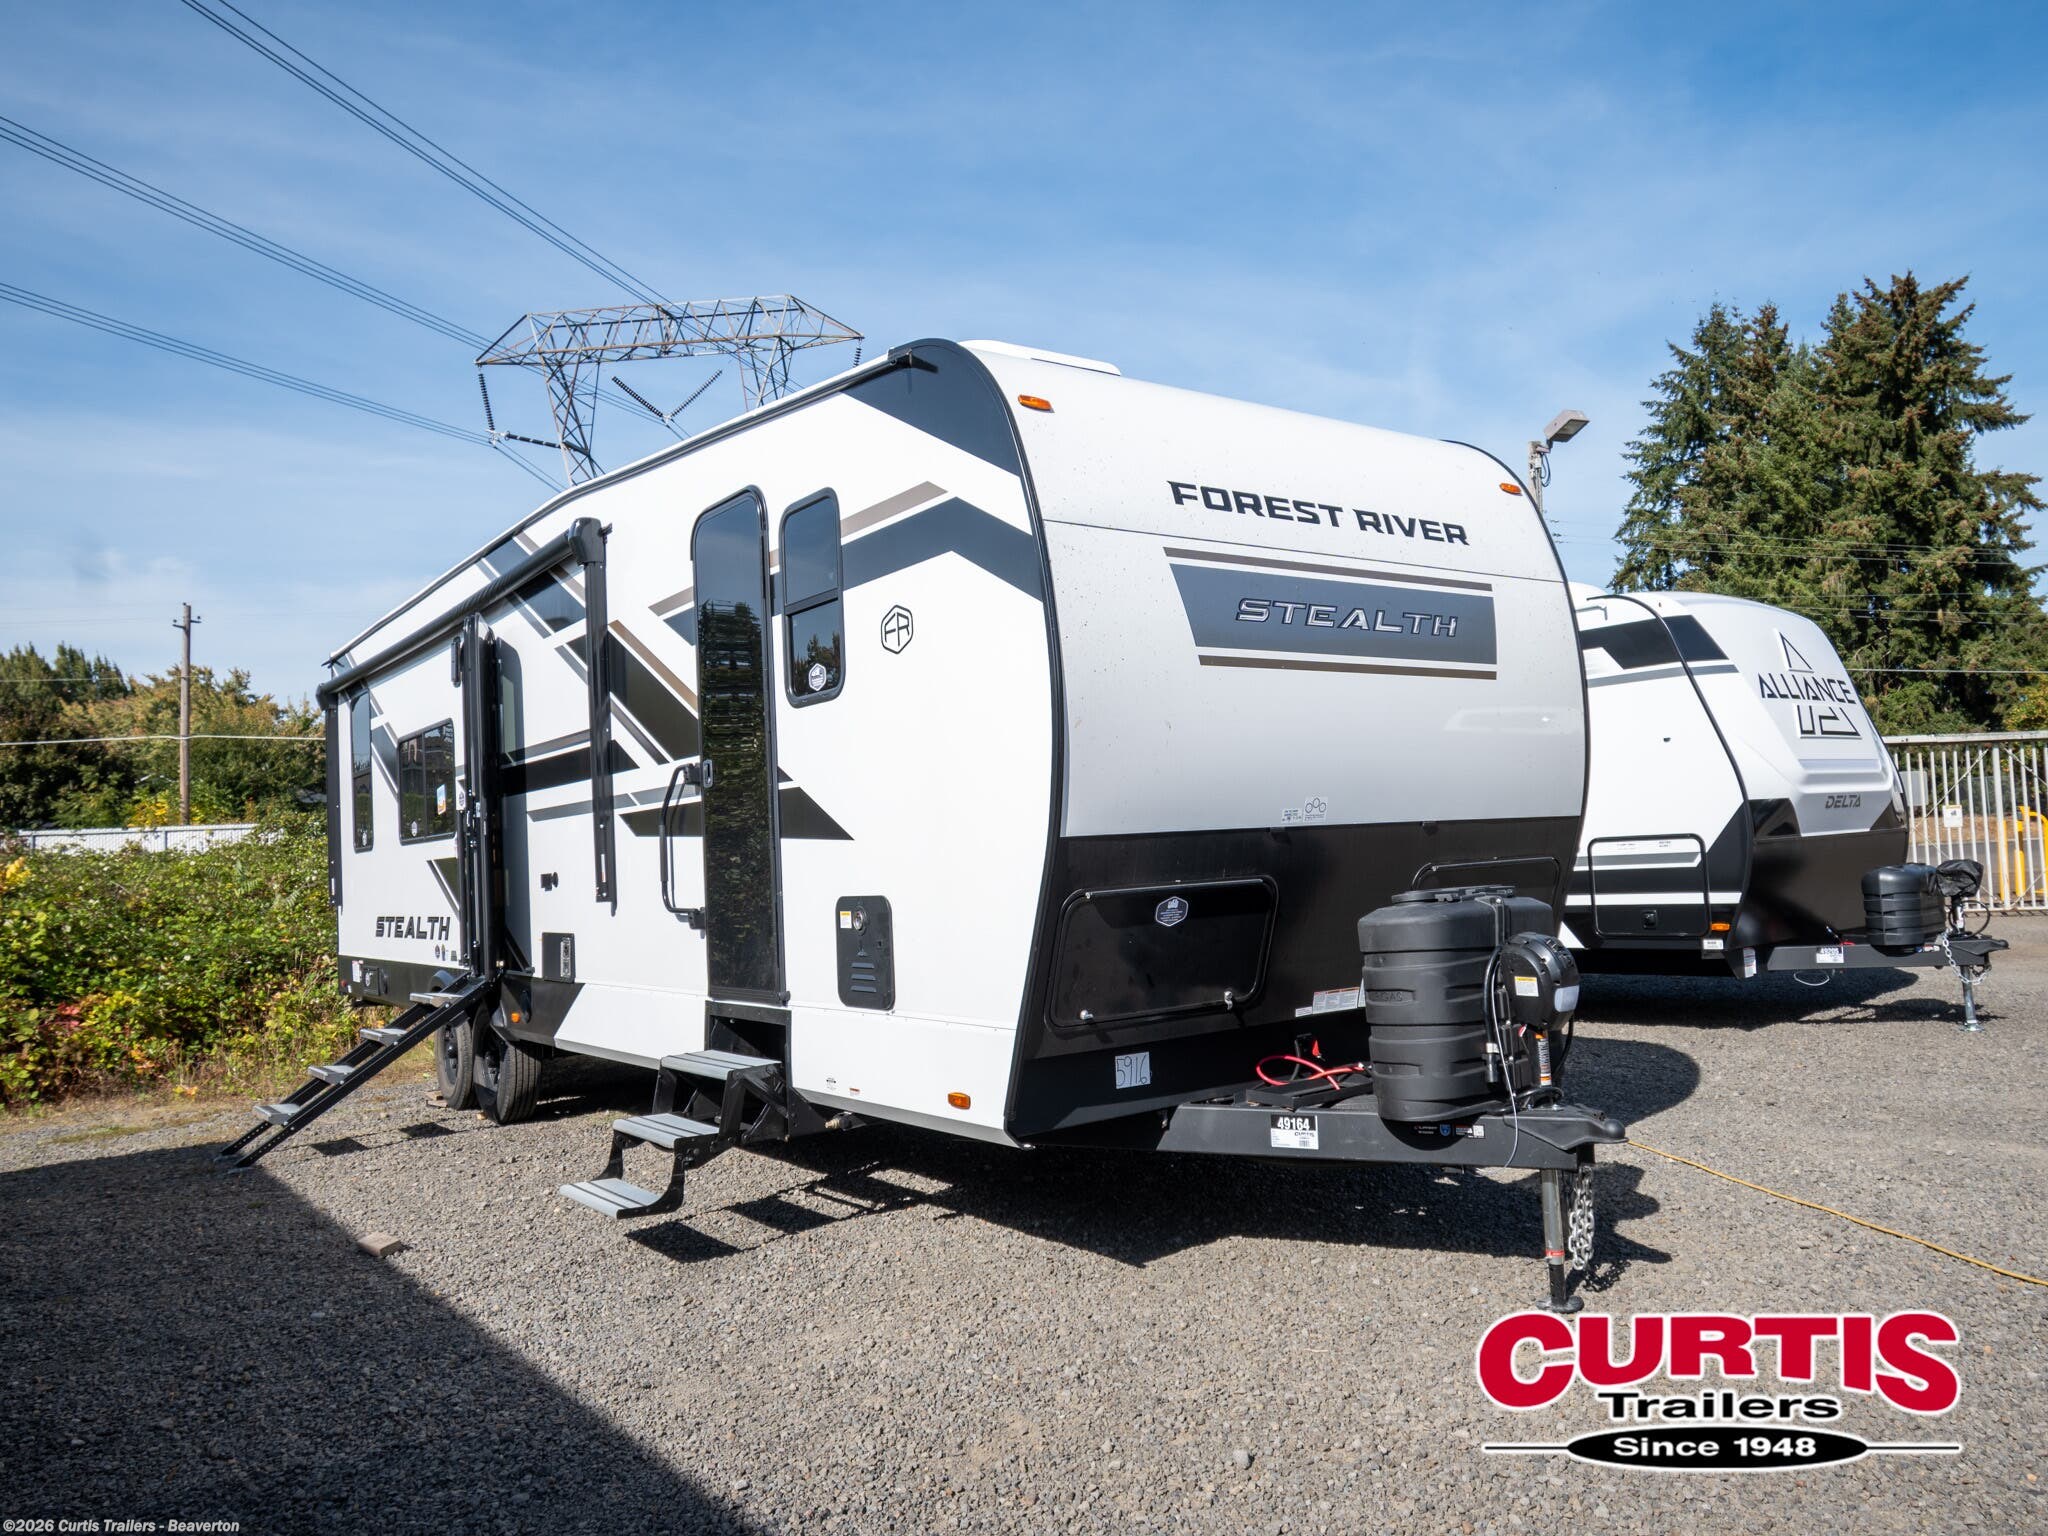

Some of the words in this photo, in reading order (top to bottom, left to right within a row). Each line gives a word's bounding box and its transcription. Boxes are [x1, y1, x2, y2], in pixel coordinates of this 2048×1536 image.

[1167, 480, 1343, 527] FOREST
[1352, 508, 1470, 545] RIVER
[1235, 597, 1458, 637] STEALTH
[1758, 672, 1856, 705] ALLIANCE
[1825, 794, 1861, 809] DELTA
[375, 915, 451, 941] STEALTH
[1277, 1116, 1310, 1131] 49164
